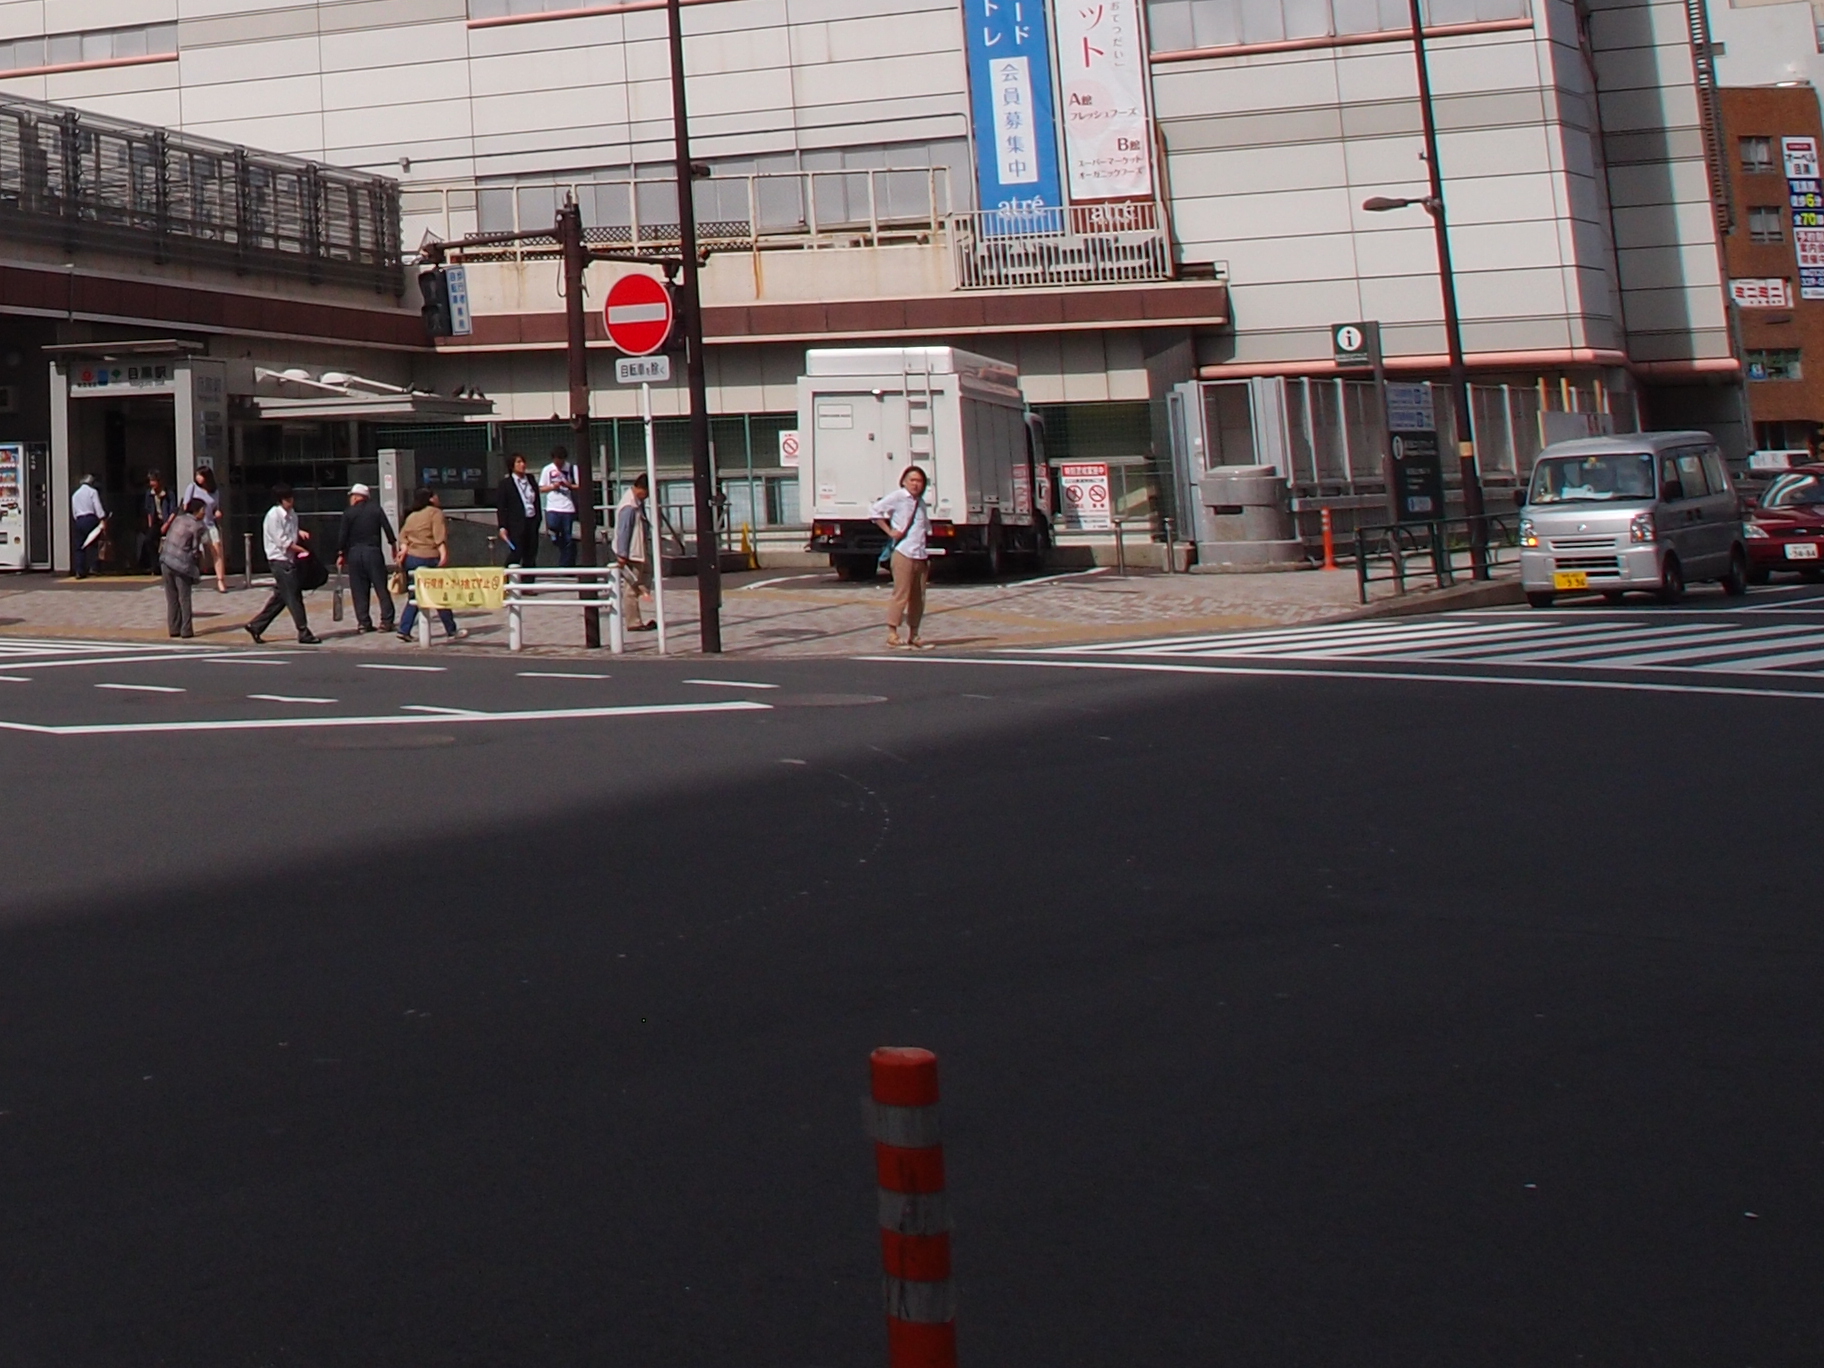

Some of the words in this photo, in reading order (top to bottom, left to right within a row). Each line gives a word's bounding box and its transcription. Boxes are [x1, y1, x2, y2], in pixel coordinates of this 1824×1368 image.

[1000, 63, 1027, 178] 会員募集中
[1070, 107, 1138, 121] フレッシュフーズ
[998, 194, 1045, 215] atré
